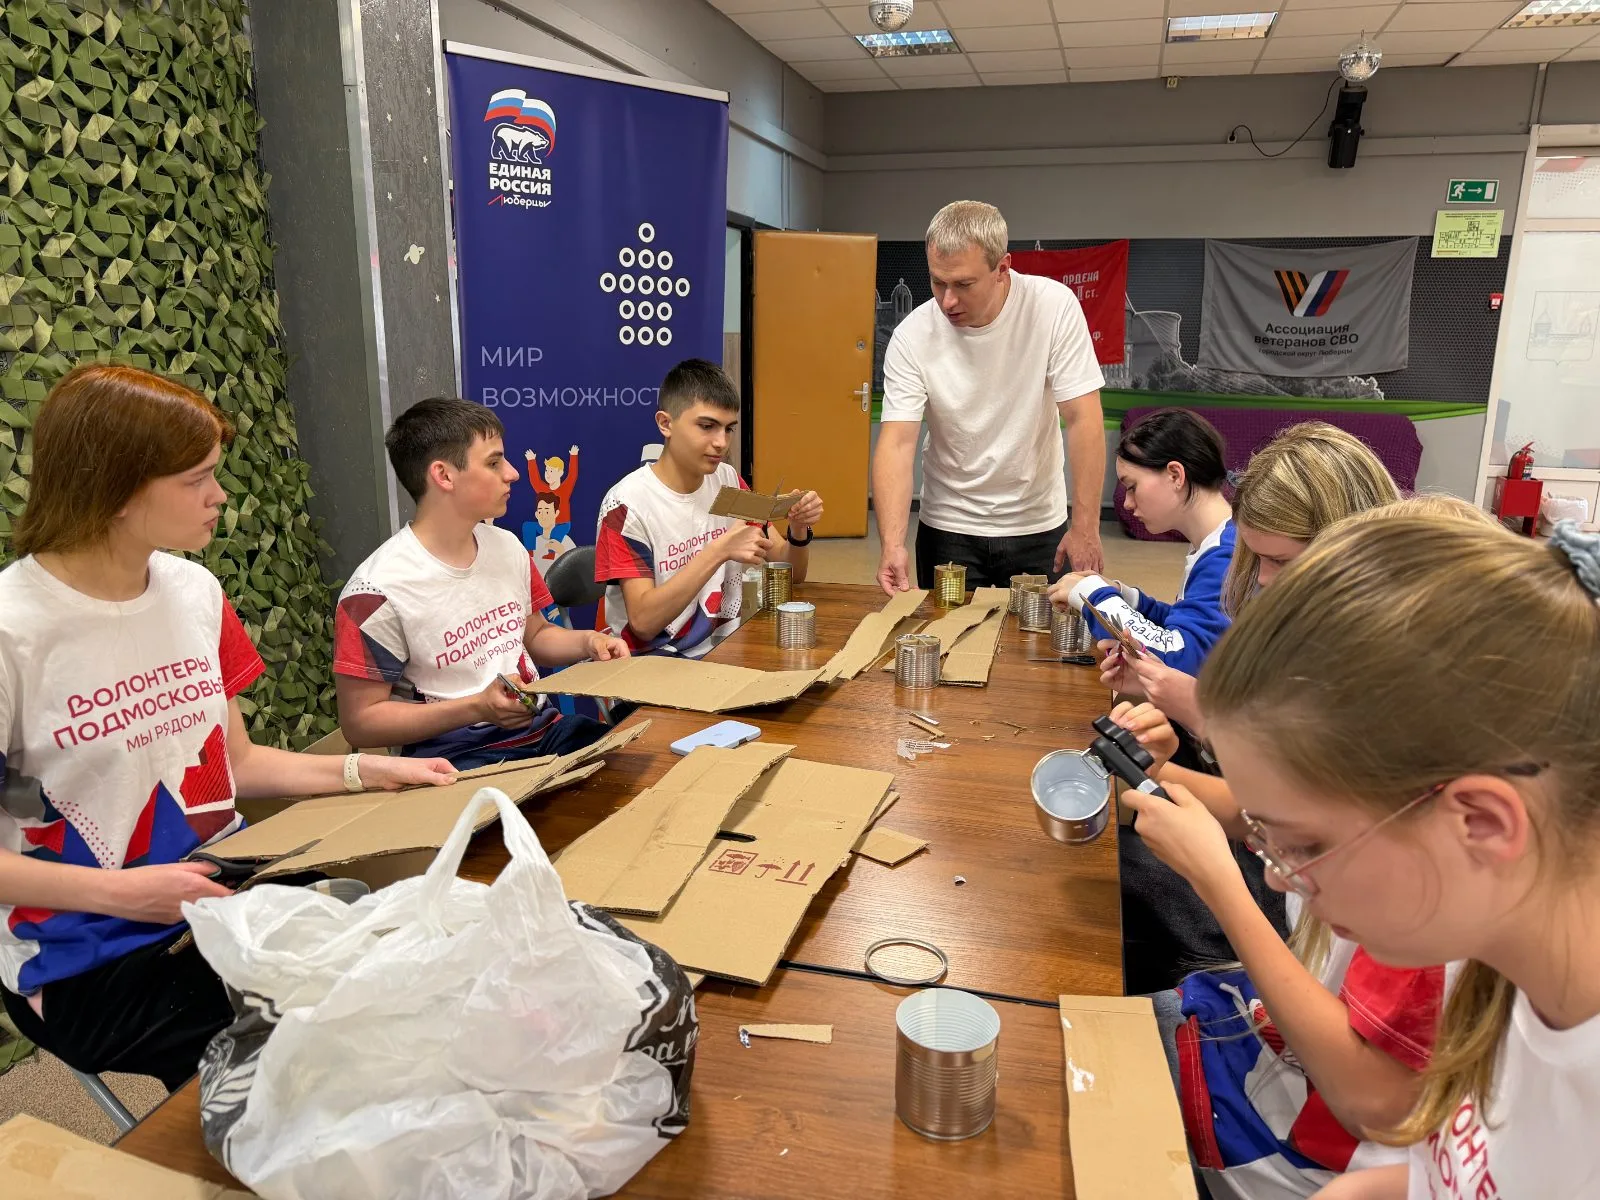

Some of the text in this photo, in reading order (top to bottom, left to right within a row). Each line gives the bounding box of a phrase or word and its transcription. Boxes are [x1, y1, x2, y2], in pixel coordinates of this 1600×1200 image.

[489, 162, 551, 180] ЕДИНАЯ
[489, 177, 552, 195] РОССИЯ
[488, 194, 552, 209] Люберцы
[1062, 271, 1099, 285] ОРДЕНА
[1265, 323, 1350, 336] Ассоциация
[1254, 333, 1359, 349] ветеранов СВО
[481, 345, 543, 367] МИР
[473, 653, 488, 670] МЫ
[67, 655, 212, 718] ВОЛОНТЕРЫ
[126, 710, 207, 753] МЫ РЯДОМ
